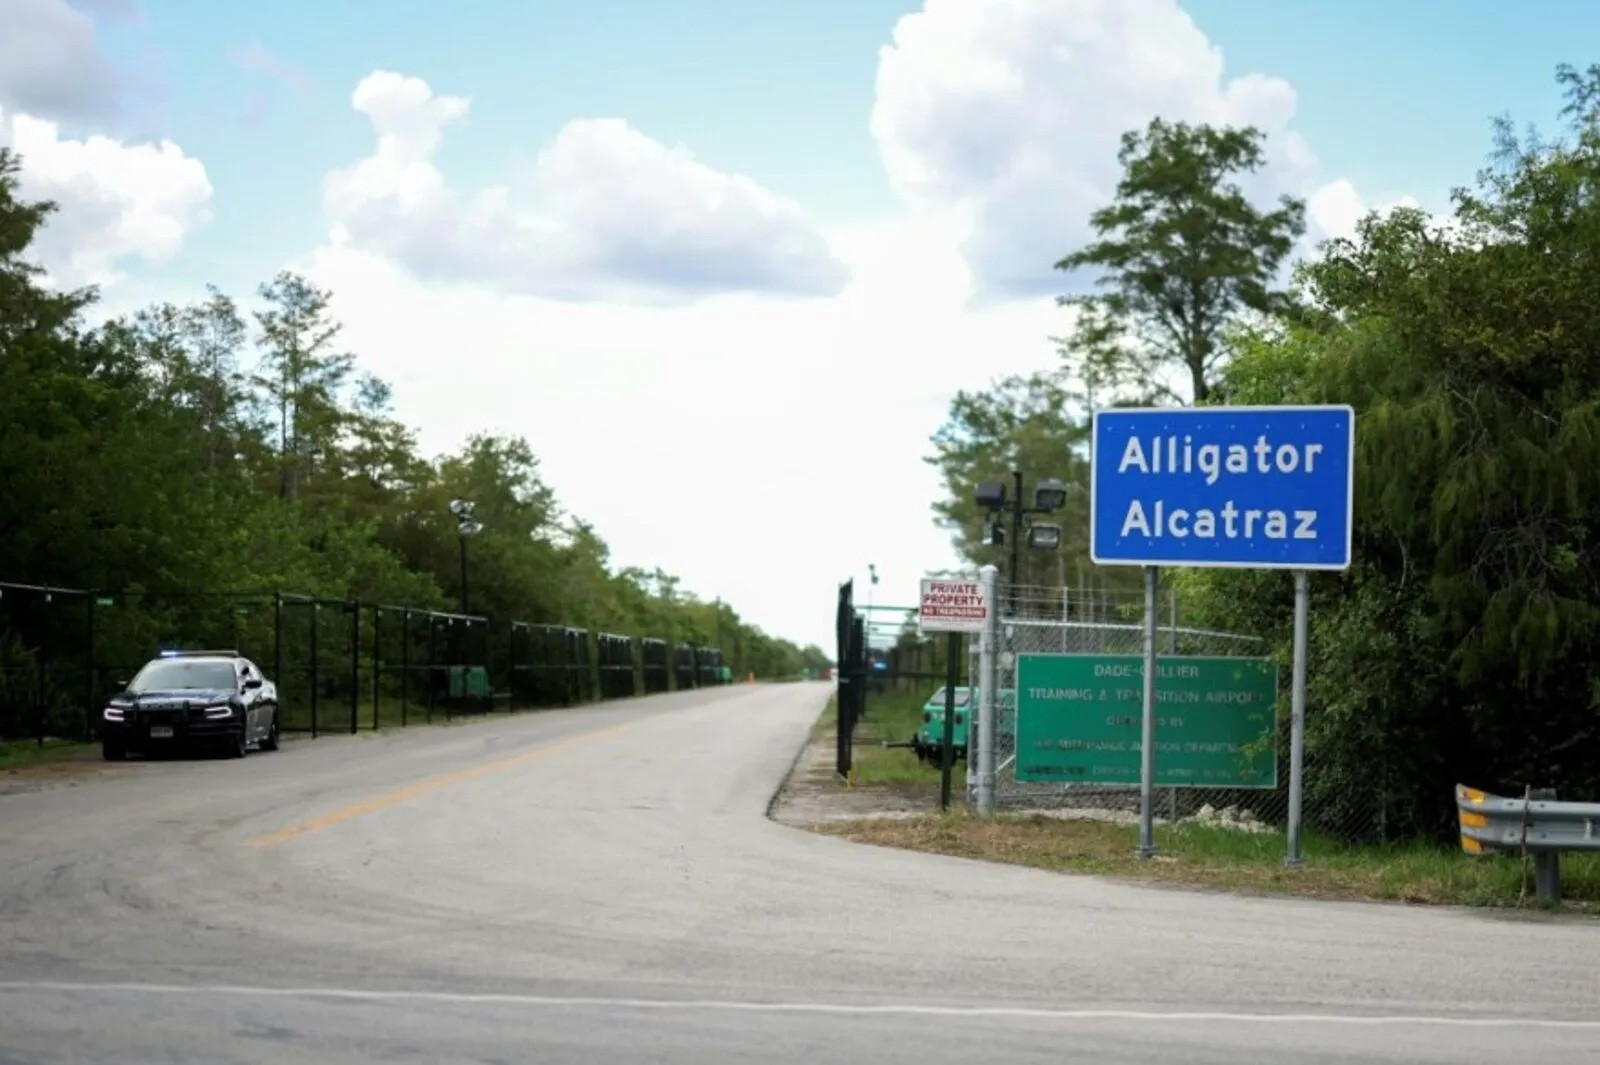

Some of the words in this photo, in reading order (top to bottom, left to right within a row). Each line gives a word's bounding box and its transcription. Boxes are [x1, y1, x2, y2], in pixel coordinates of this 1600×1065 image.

[1118, 435, 1323, 486] Alligator
[1120, 500, 1318, 539] Alcatraz
[930, 583, 977, 594] PRIVATE
[923, 594, 983, 606] PROPERTY
[1028, 687, 1093, 701] TRAINING
